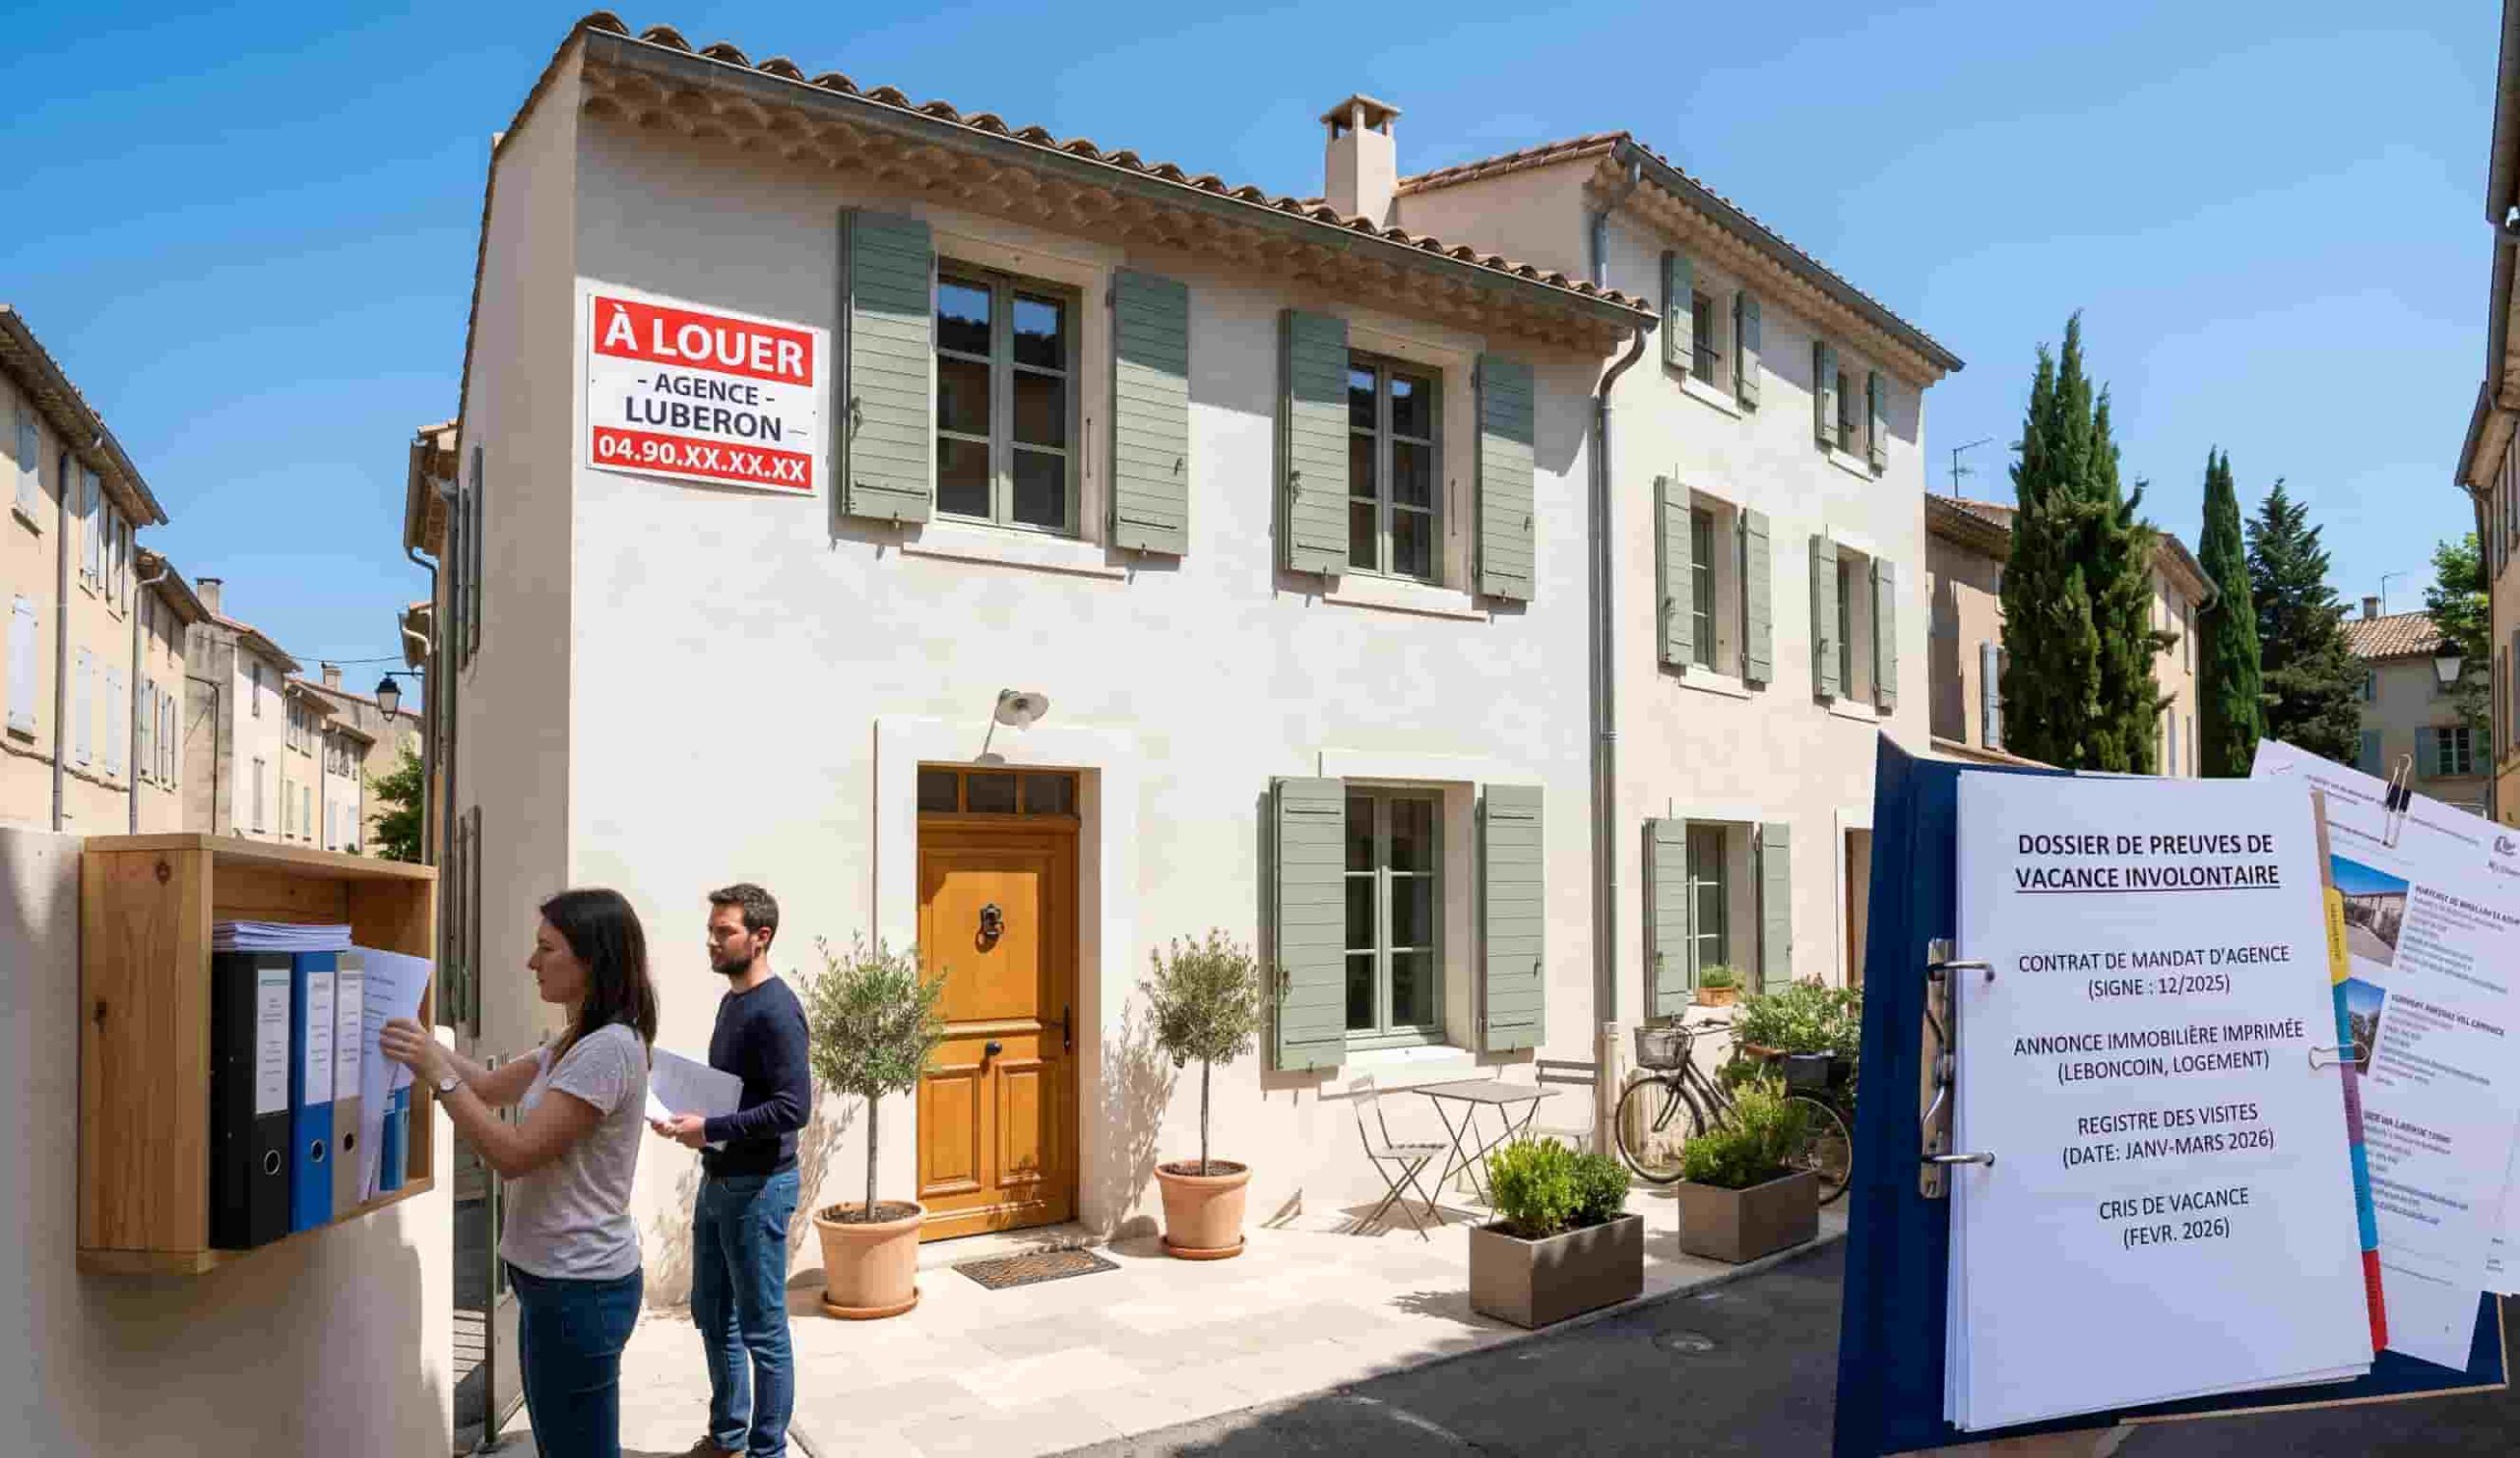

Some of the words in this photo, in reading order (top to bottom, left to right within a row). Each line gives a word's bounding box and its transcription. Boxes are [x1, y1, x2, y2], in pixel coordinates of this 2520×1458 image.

[603, 304, 638, 351] À
[653, 318, 804, 377] LOUER
[655, 373, 758, 406] AGENCE
[626, 397, 782, 442] LUBERON
[598, 435, 805, 481] 04.90.XX.XX.XX
[2019, 835, 2110, 855] DOSSIER
[2116, 836, 2143, 855] DE
[2150, 835, 2241, 855] PREUVES
[2247, 835, 2274, 853] DE
[2015, 867, 2119, 888] VACANCE
[2126, 865, 2280, 887] INVOLONTAIRE
[2019, 953, 2103, 973] CONTRAT
[2105, 952, 2127, 970] DE
[2132, 949, 2205, 968] MANDAT
[2210, 945, 2291, 966] D'AGENCE
[2088, 979, 2144, 1001] (SIGNE
[2159, 974, 2231, 996] 12/2025)
[2013, 1033, 2104, 1056] ANNONCE
[2108, 1025, 2218, 1050] IMMOBILIÈRE
[2223, 1018, 2304, 1043] IMPRIMÉE
[2057, 1057, 2169, 1087] (LEBONCOIN,
[2173, 1049, 2270, 1073] LOGEMENT)
[2078, 1111, 2159, 1136] REGISTRE
[2163, 1109, 2196, 1128] DES
[2198, 1104, 2259, 1125] VISITES
[2062, 1144, 2121, 1170] (DATE:
[2125, 1134, 2225, 1161] JANV-MARS
[2228, 1128, 2274, 1151] 2026)
[2100, 1199, 2138, 1220] CRIS
[2142, 1196, 2166, 1216] DE
[2170, 1187, 2249, 1212] VACANCE
[2123, 1225, 2177, 1251] (FEVR.
[2182, 1217, 2230, 1239] 2026)
